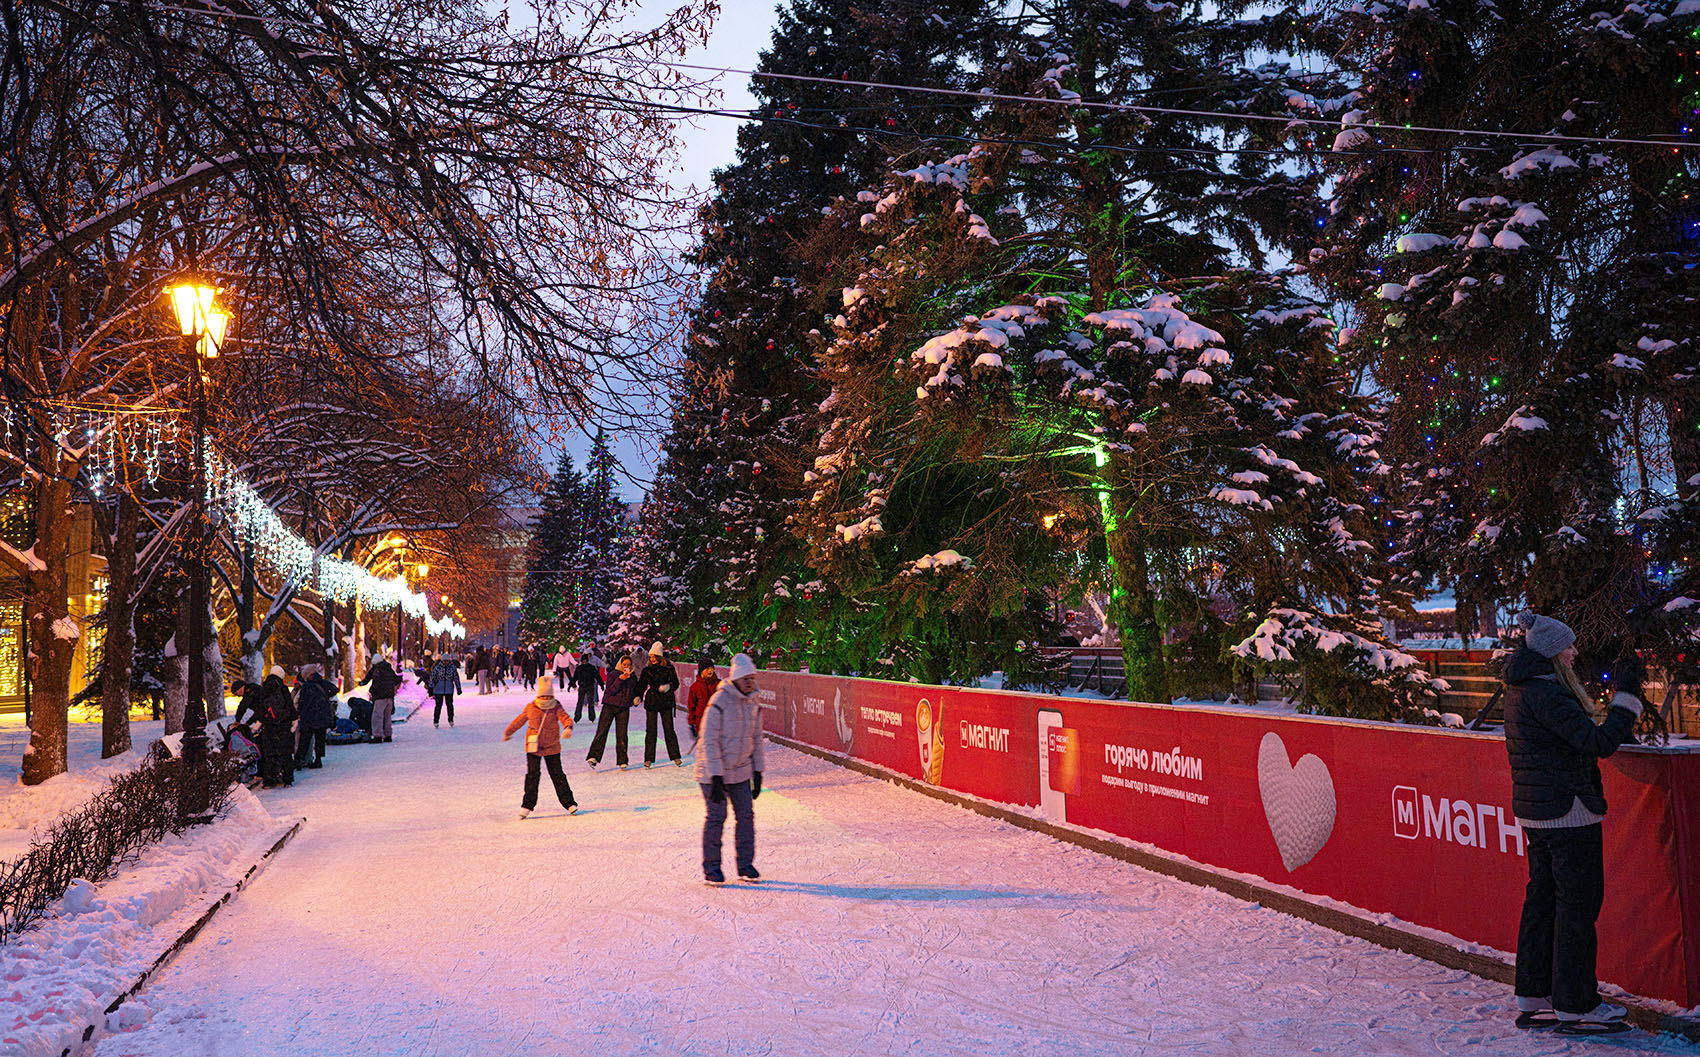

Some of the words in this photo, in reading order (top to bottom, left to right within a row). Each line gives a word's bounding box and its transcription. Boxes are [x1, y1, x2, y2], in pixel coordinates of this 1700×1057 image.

[968, 723, 1010, 753] магнит
[1105, 743, 1149, 774] горячо
[1151, 746, 1203, 781] любим
[1101, 774, 1124, 788] подарим
[1124, 778, 1143, 795] выгоду
[1144, 783, 1149, 792] в
[1149, 784, 1186, 800] приложении
[1186, 791, 1209, 806] магнит
[1422, 794, 1530, 857] магн
